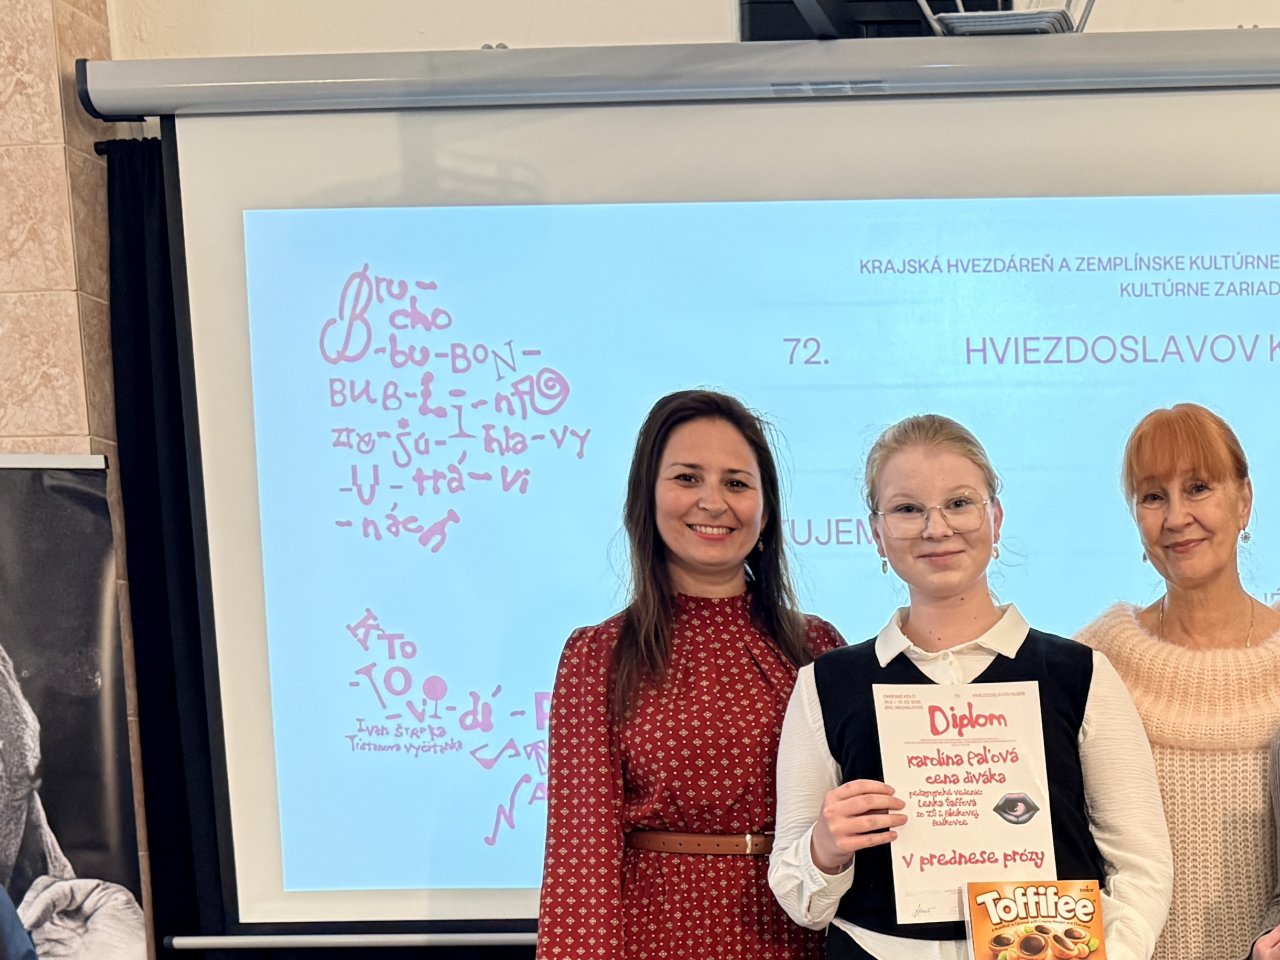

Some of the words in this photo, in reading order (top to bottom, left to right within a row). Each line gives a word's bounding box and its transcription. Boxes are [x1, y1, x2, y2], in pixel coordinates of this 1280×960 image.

[860, 254, 942, 274] KRAJSKÁ
[947, 254, 1054, 273] HVEZDÁREŇ
[1058, 257, 1071, 272] A
[1075, 252, 1185, 272] ZEMPLÍNSKE
[1189, 252, 1280, 271] KULTÚRNE
[1120, 278, 1210, 298] KULTÚRNE
[389, 295, 453, 331] cho
[783, 338, 830, 365] 72.
[966, 333, 1260, 365] HVIEZDOSLAVOV
[928, 701, 1008, 738] Diplom
[925, 774, 960, 784] cena
[963, 767, 1006, 784] diváka
[918, 797, 943, 807] Lenka
[920, 849, 999, 872] prednese
[1003, 849, 1045, 868] prózy
[976, 885, 1095, 926] Toffifee
